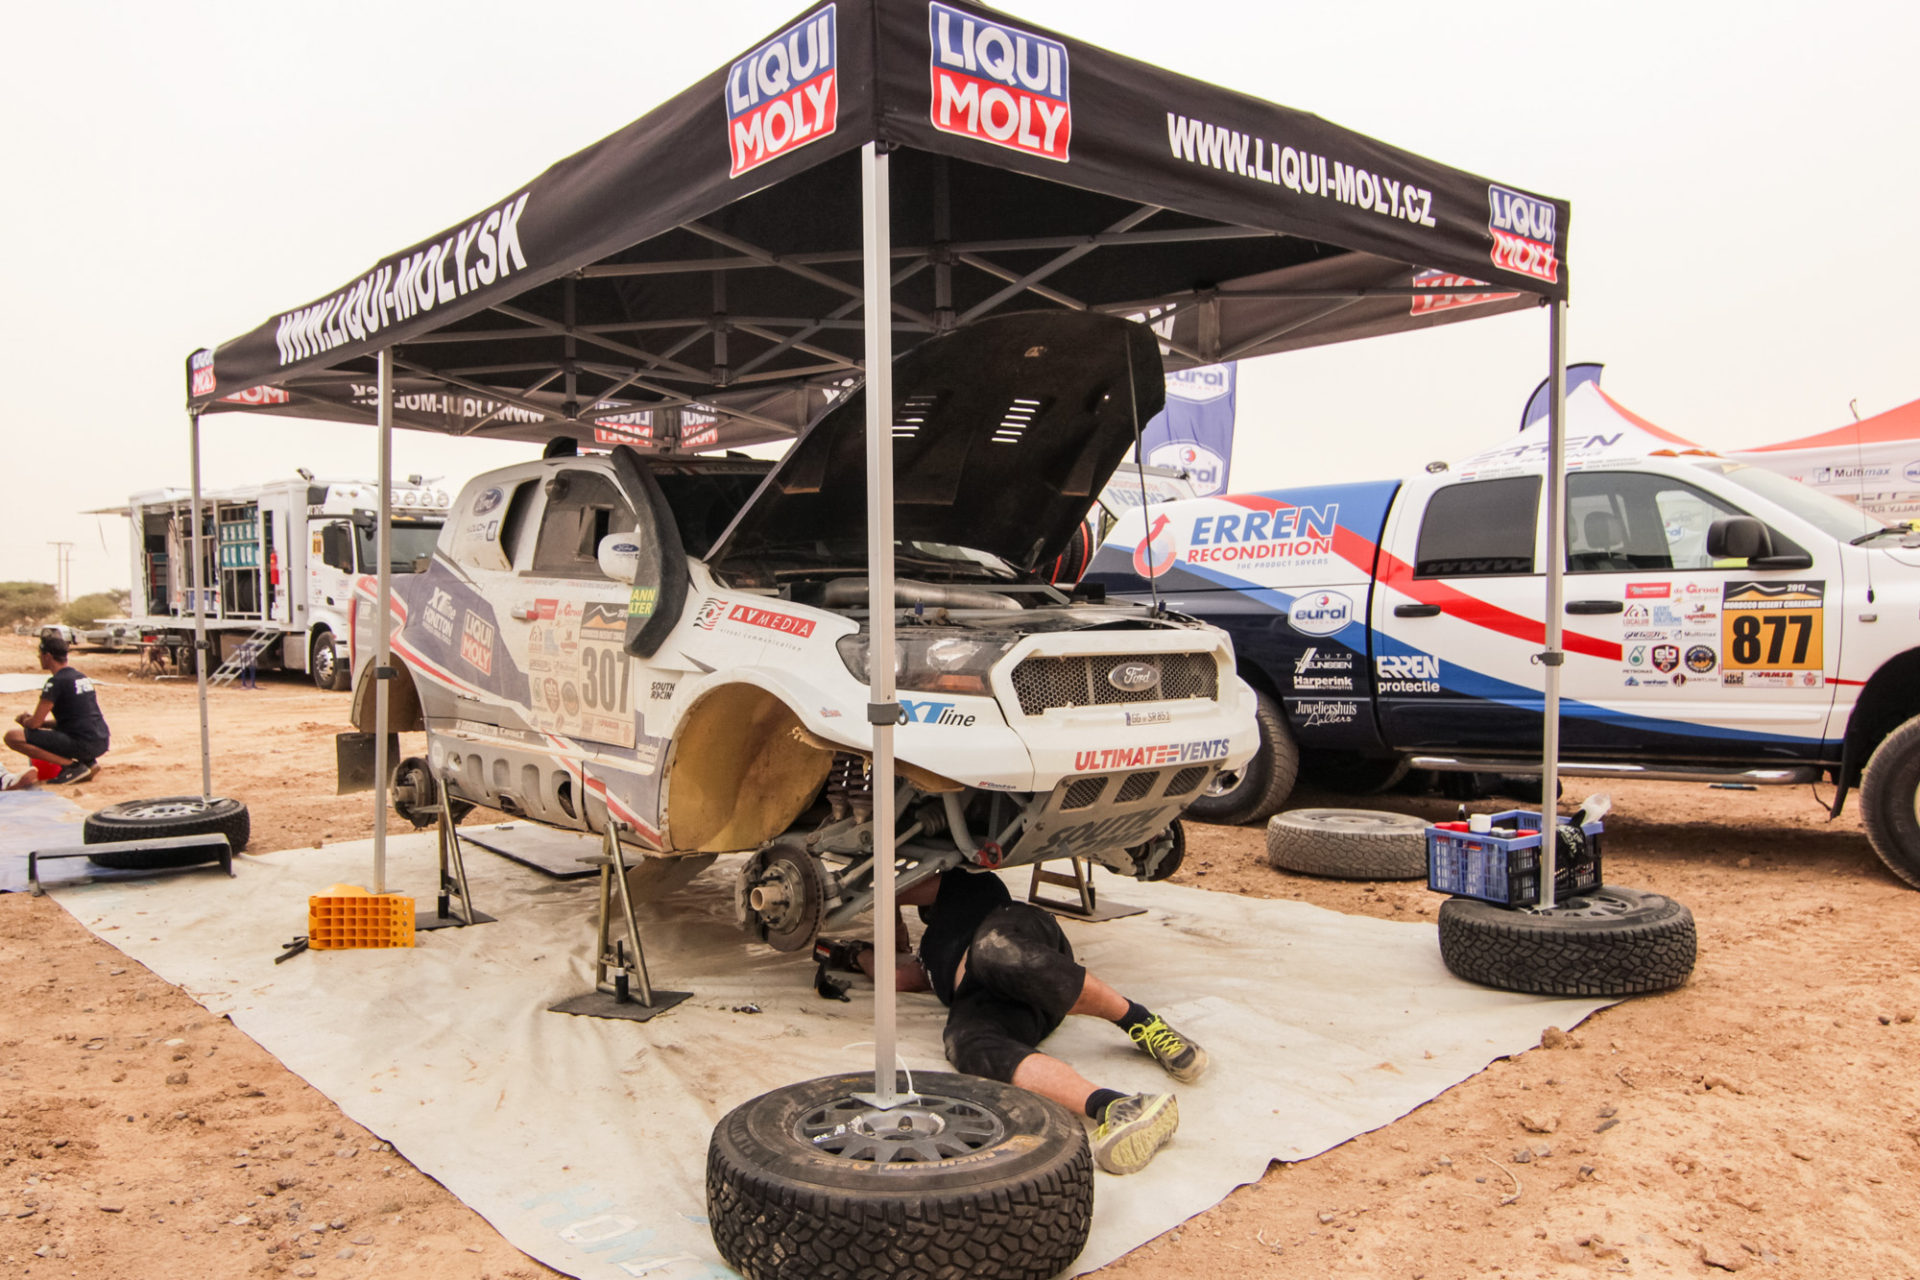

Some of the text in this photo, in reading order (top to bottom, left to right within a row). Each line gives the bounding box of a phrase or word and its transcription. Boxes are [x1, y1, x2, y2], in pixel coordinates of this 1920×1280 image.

[732, 13, 829, 114] LIQUI
[938, 12, 1062, 97] LIQUI
[734, 75, 834, 169] MOLY
[939, 75, 1067, 153] MOLY
[1167, 112, 1436, 228] WWW.LIQUI-MOLY.CZ
[1490, 189, 1553, 241] LIQUI
[1494, 235, 1554, 277] MOLY
[276, 192, 530, 366] WWW.LIQUI-MOLY.SK
[1834, 467, 1891, 478] Multimax
[1190, 503, 1338, 546] ERREN
[1187, 537, 1331, 563] RECONDITION
[1254, 560, 1292, 568] PRODUCT
[1786, 584, 1806, 592] 2017
[732, 607, 810, 636] AVMEDIA
[1295, 606, 1346, 620] eurol
[466, 613, 493, 649] LIQUI
[1732, 615, 1812, 664] 877
[463, 635, 491, 669] MOLY
[1376, 655, 1440, 679] ERREN
[582, 646, 631, 714] 307
[651, 682, 675, 691] SOUTH
[1123, 666, 1151, 684] Ford
[1293, 676, 1352, 689] Harperink
[1378, 681, 1440, 694] protectie
[1296, 701, 1357, 715] Juweliershuis
